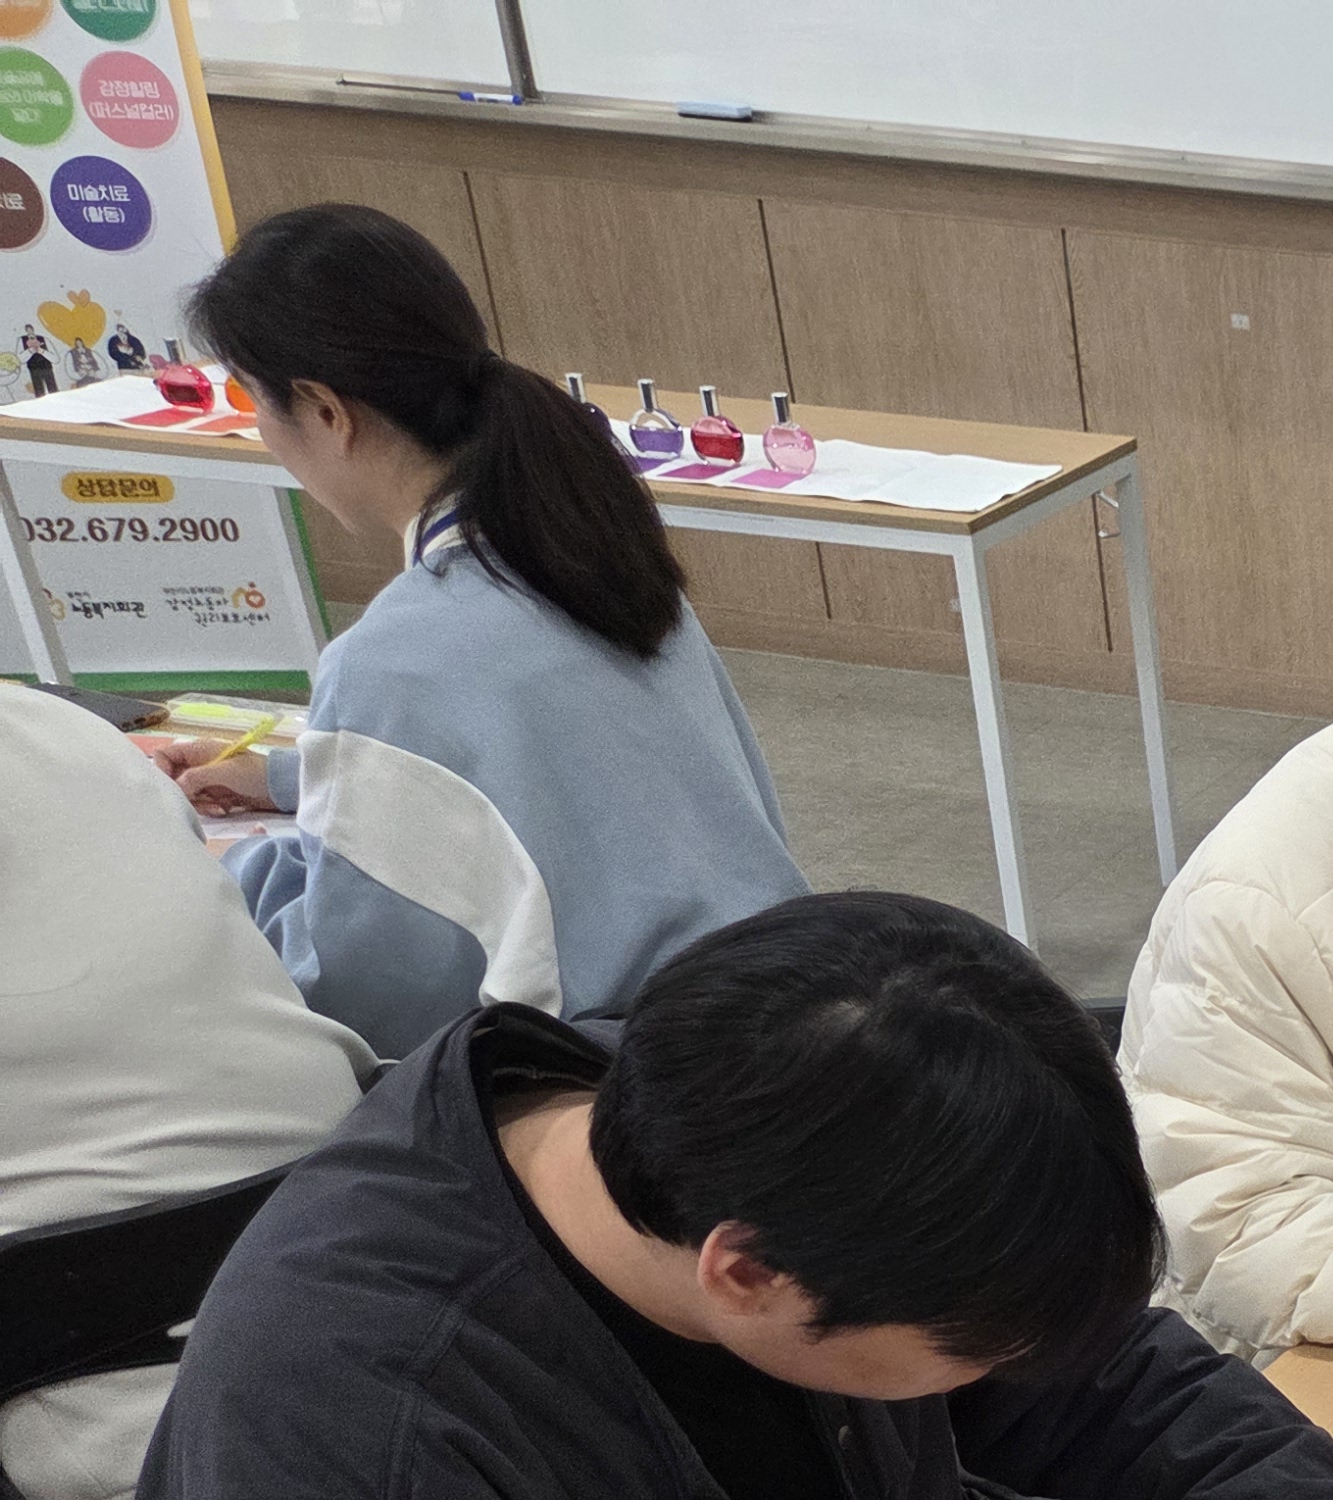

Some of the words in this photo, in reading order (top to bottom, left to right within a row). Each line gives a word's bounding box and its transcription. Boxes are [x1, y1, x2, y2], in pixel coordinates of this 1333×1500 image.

[89, 103, 174, 121] (퍼스널컬러)
[67, 184, 131, 202] 미술치료
[83, 207, 125, 224] (활동)
[77, 478, 160, 498] 상담문의
